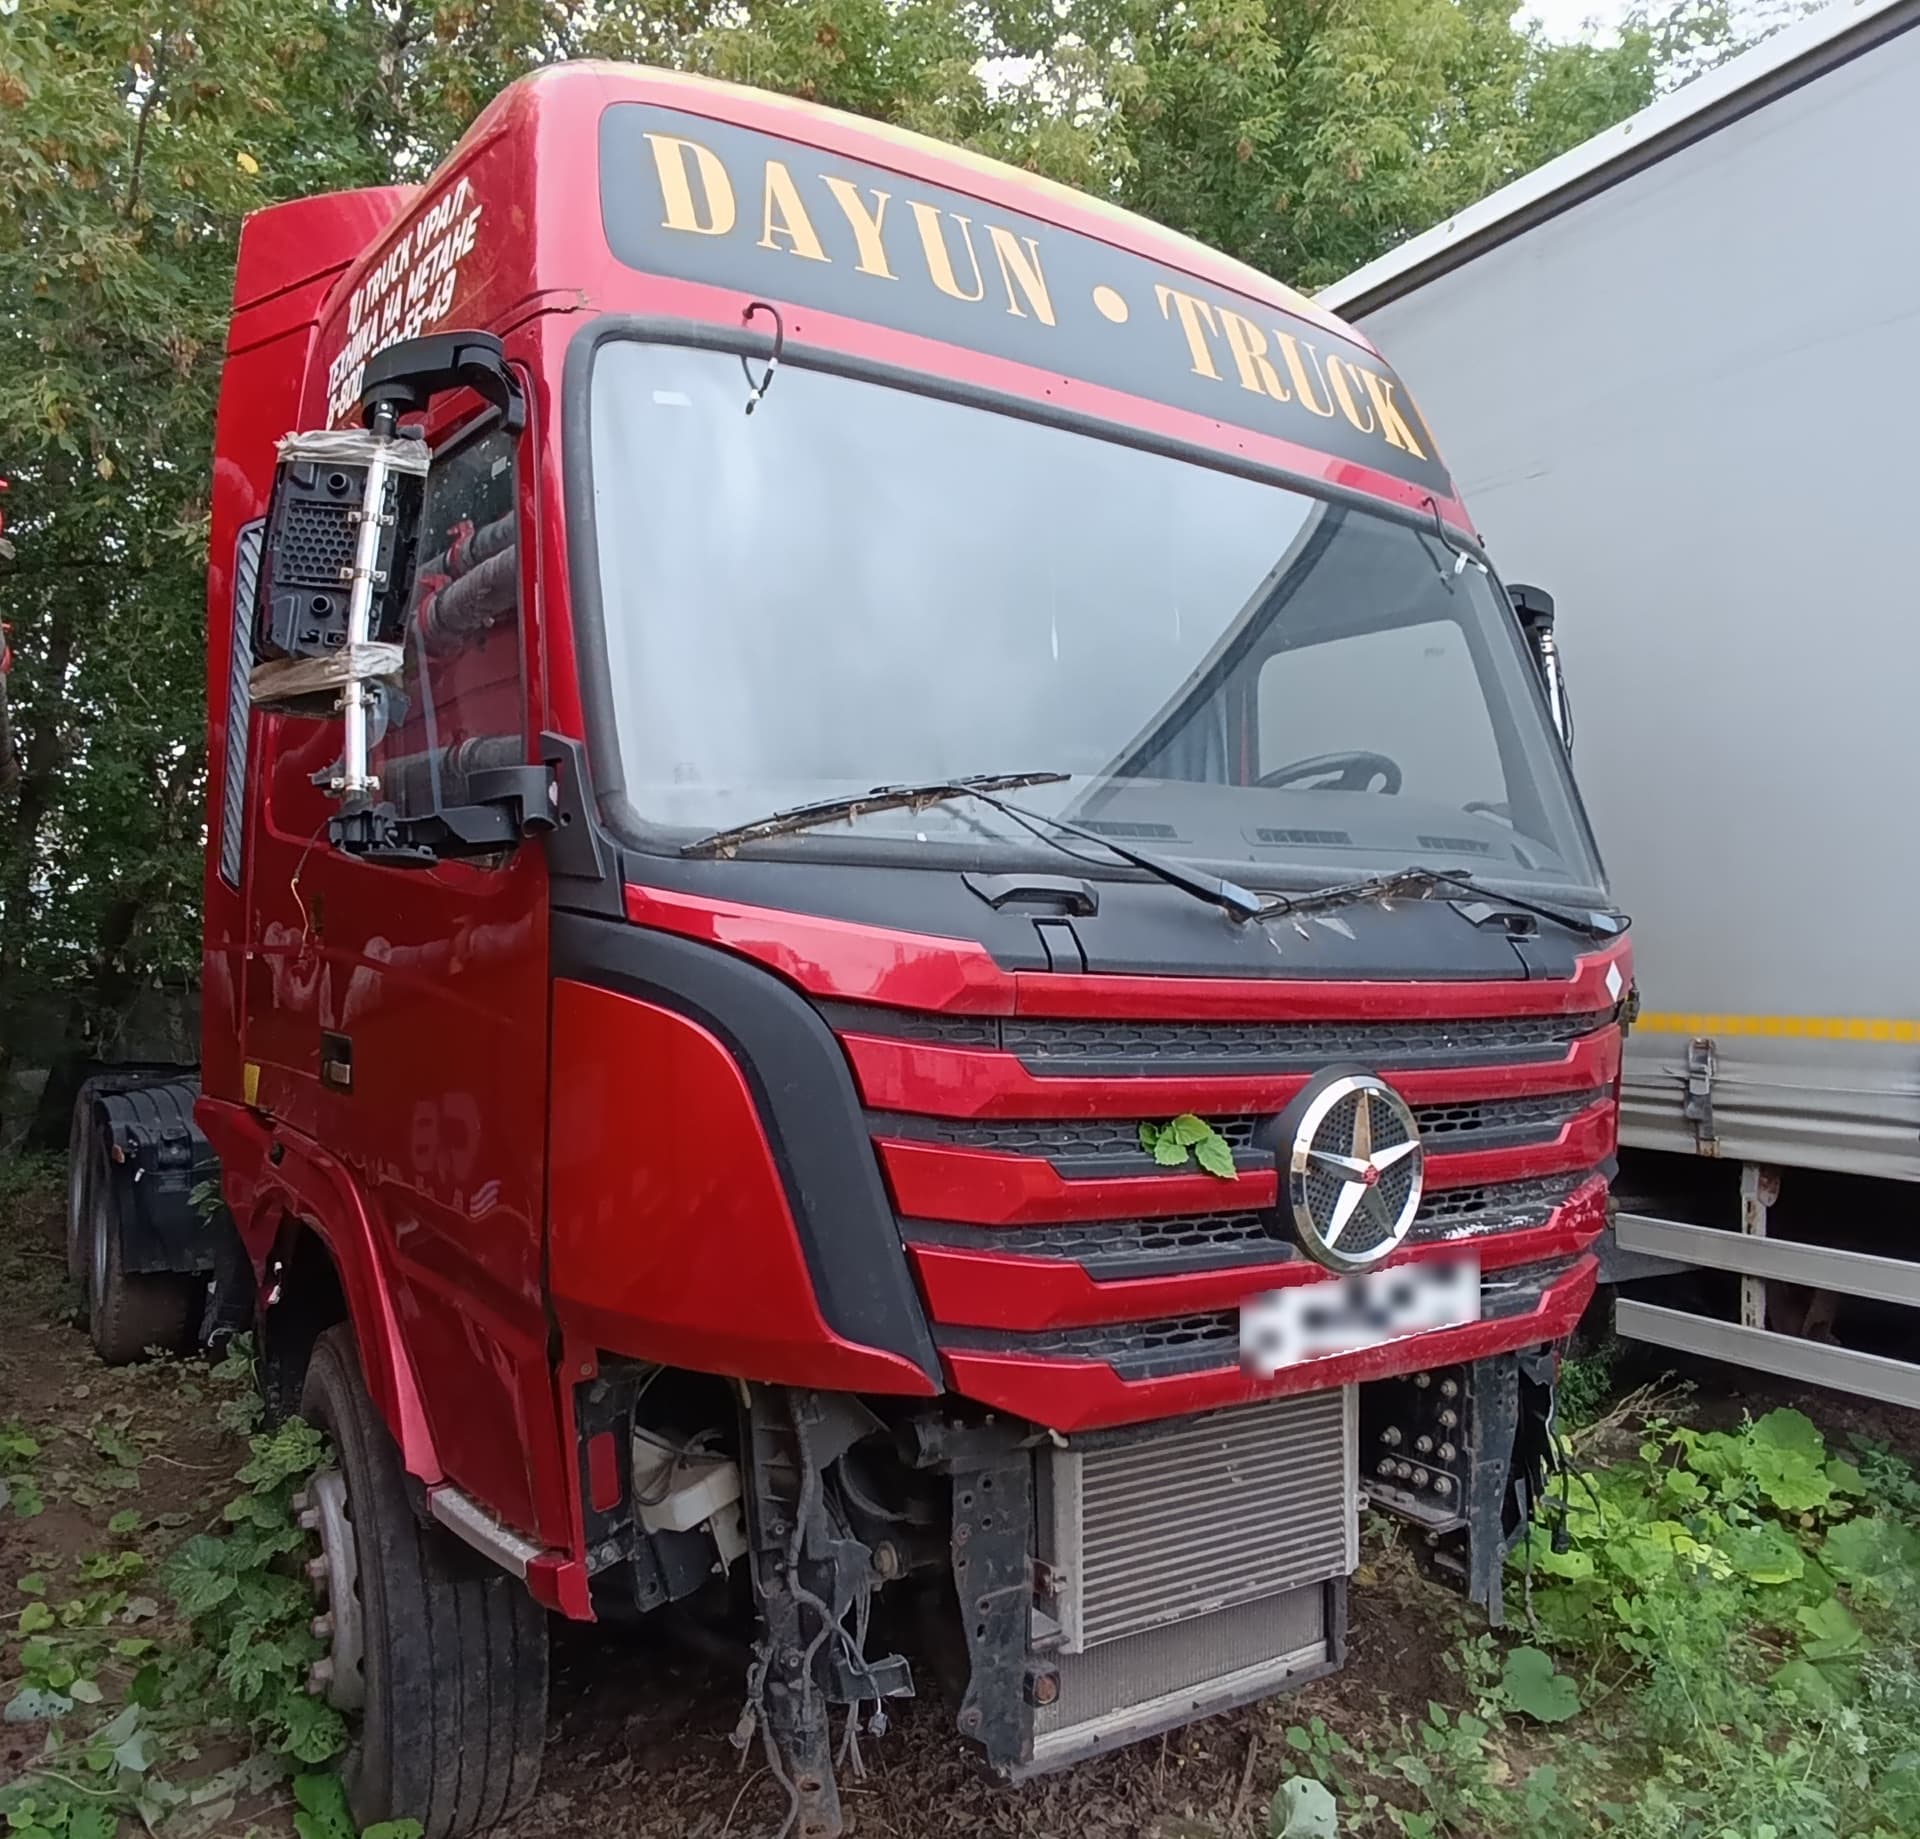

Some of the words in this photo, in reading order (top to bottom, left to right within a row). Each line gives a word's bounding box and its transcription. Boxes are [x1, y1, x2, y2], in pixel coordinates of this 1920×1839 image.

[327, 310, 379, 399] ТЕХНИКА
[381, 283, 403, 337] НА
[404, 204, 483, 312] МЕТАНЕ
[364, 231, 414, 313] TRUCK
[414, 176, 469, 259] УРАЛ
[643, 132, 1057, 326] DAYUN
[1155, 284, 1428, 461] TRUCK
